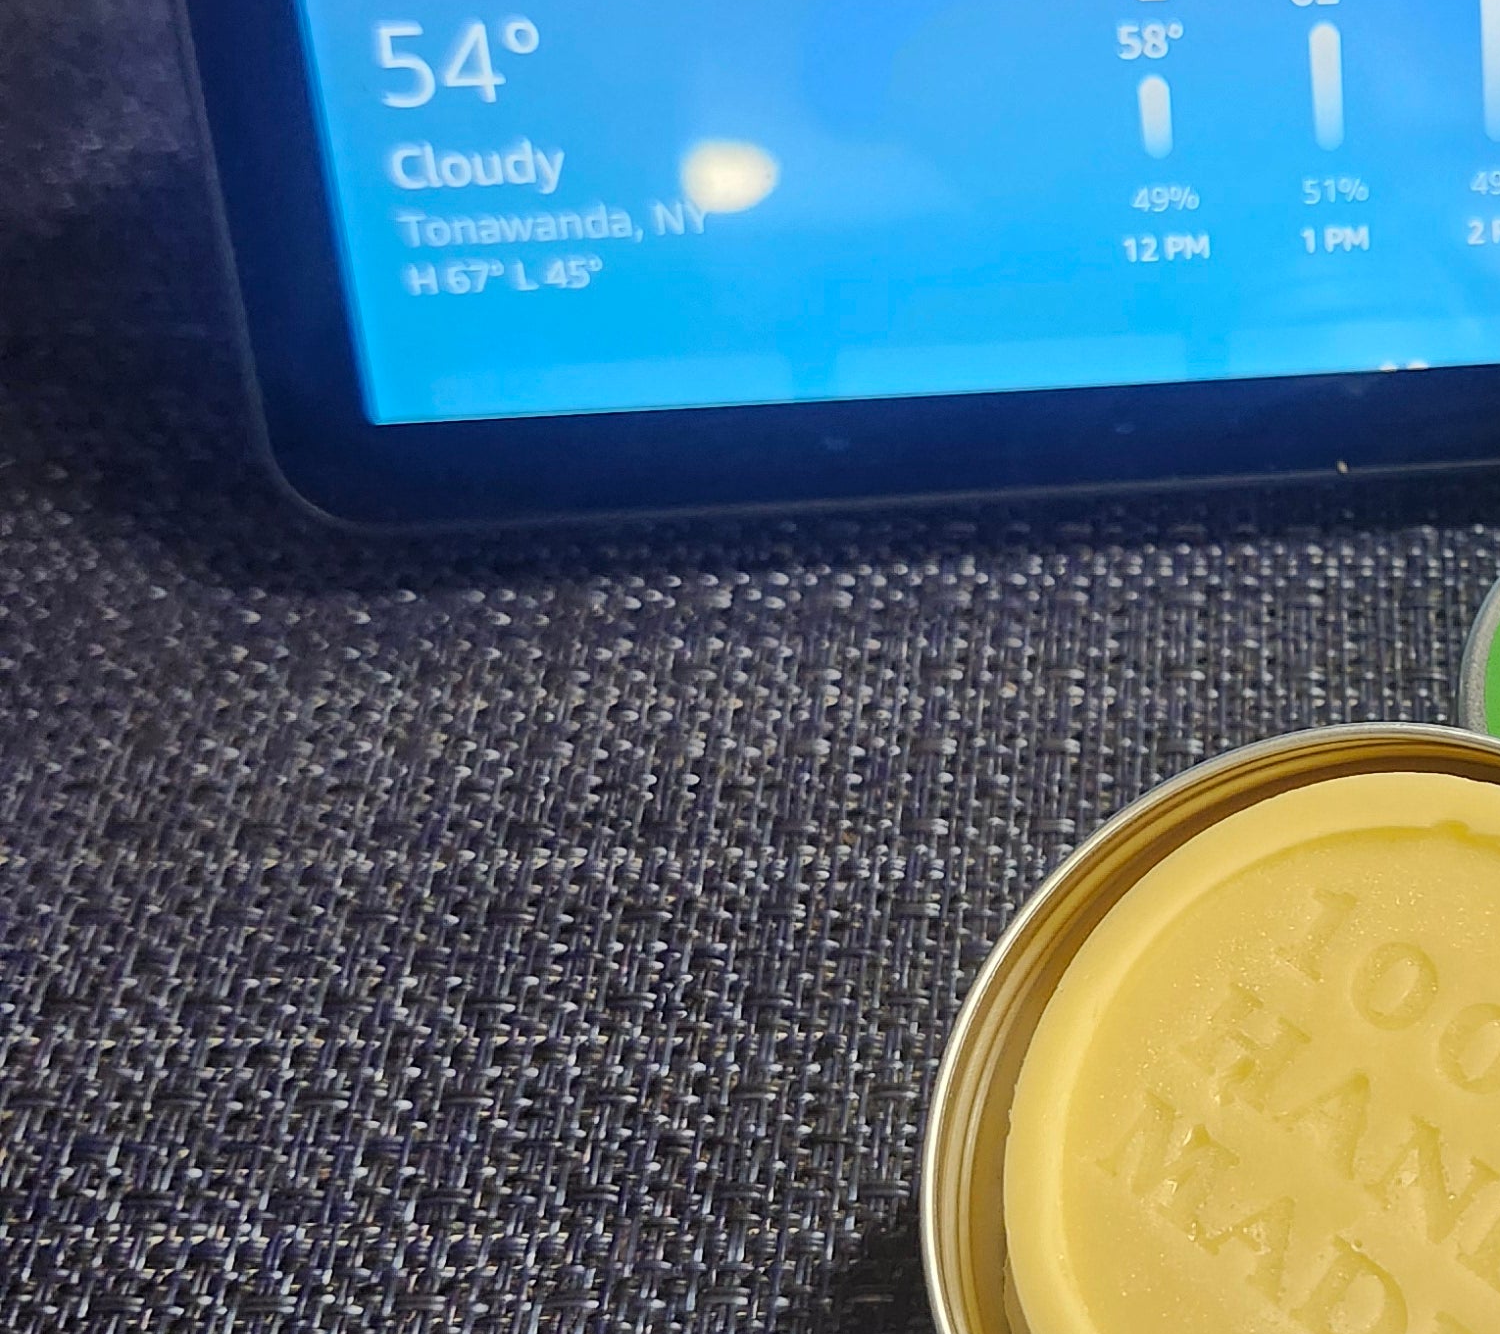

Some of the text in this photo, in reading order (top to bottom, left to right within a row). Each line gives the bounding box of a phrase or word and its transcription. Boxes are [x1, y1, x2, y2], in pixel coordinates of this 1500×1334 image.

[392, 138, 566, 193] Cloudy
[1131, 184, 1200, 213] 49%
[1302, 177, 1370, 205] 51%
[401, 199, 708, 249] Tonawanda, NY
[1301, 224, 1370, 253] 1 PM
[1467, 220, 1485, 245] 2
[1123, 233, 1211, 263] 12 PM
[409, 263, 440, 297] H
[516, 259, 540, 291] L
